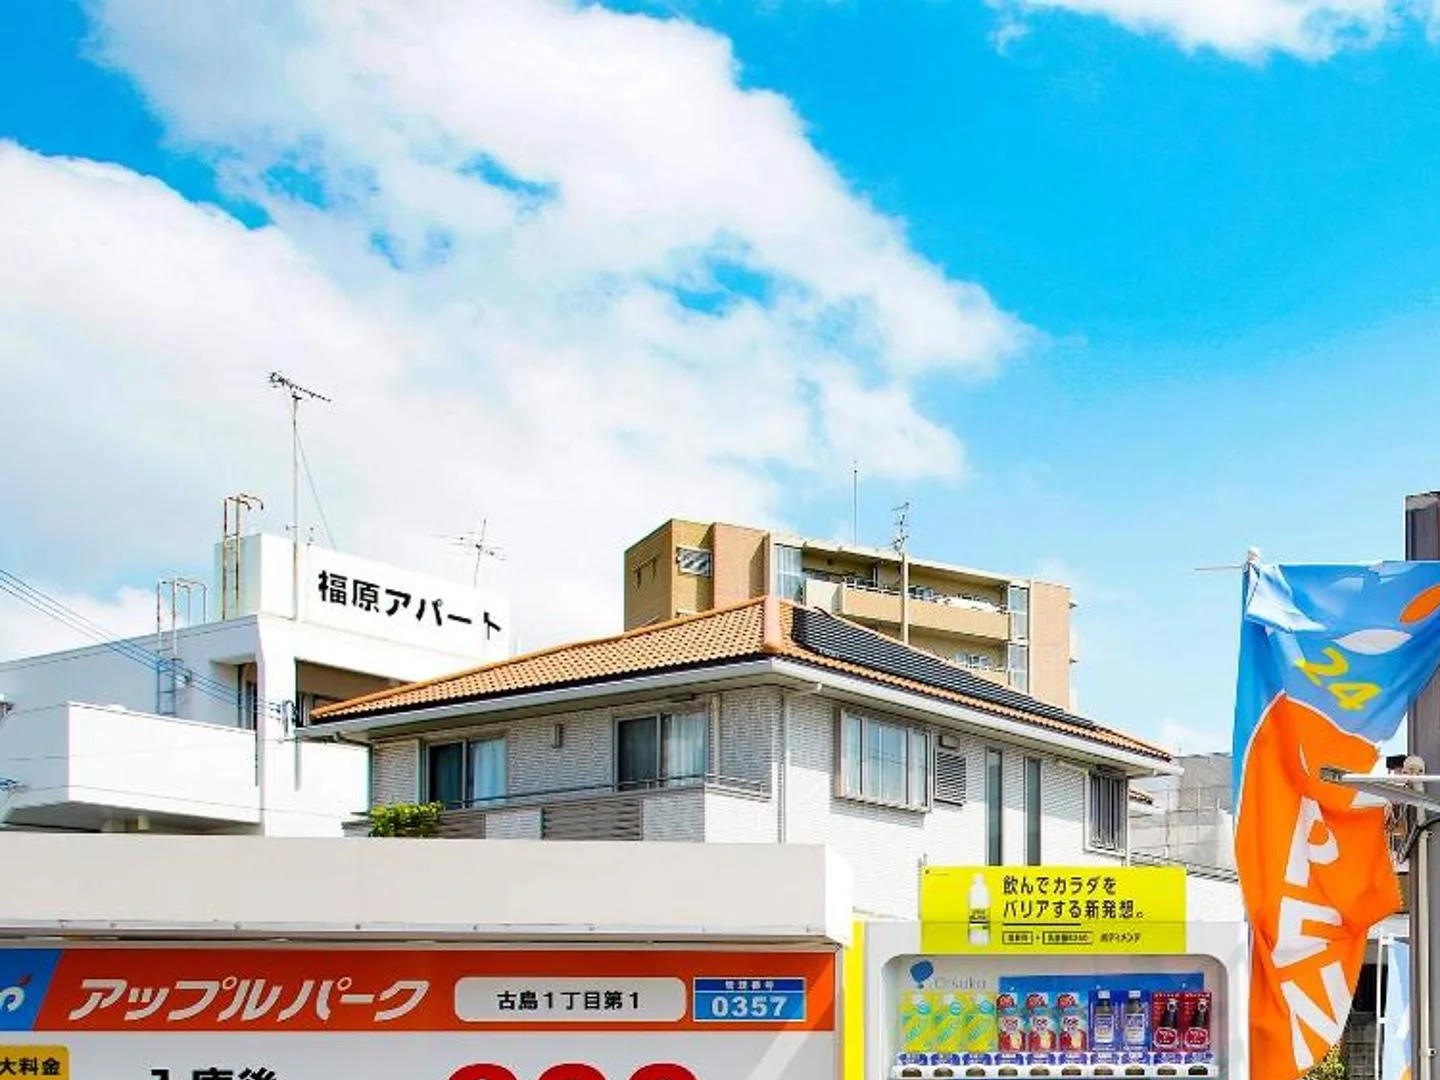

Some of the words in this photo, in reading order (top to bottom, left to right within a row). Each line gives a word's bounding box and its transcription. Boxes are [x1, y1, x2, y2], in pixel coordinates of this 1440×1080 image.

[318, 569, 502, 641] 福原アパート
[1003, 876, 1117, 896] 飲んでカラダを
[1003, 899, 1144, 919] バリアする新発想。
[1271, 745, 1375, 1071] PEN
[68, 976, 431, 1022] アップルパーク
[497, 990, 640, 1011] 古島1丁目第1
[711, 995, 787, 1018] 0357
